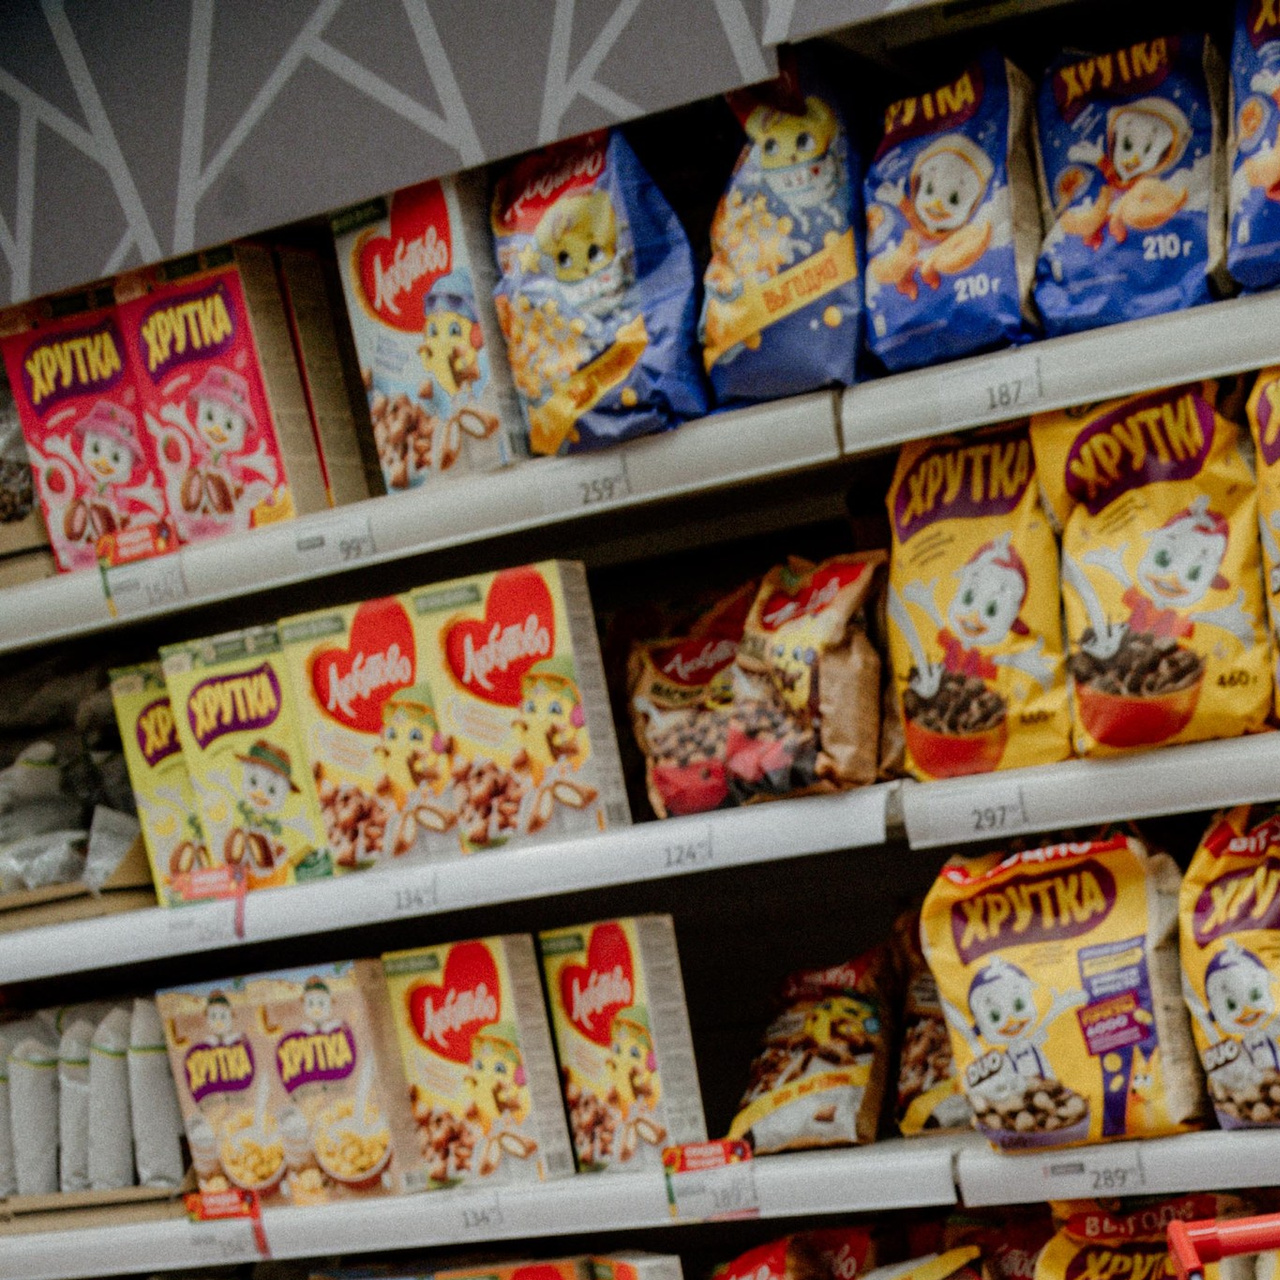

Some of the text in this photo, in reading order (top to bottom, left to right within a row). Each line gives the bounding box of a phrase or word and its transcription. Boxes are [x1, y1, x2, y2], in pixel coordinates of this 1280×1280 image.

[1142, 233, 1181, 262] 210
[954, 273, 988, 303] 210
[25, 330, 122, 405] ХРУТКА
[141, 294, 233, 372] ХРУТКА
[193, 672, 278, 743] ХРУТКА
[960, 871, 1107, 951] ХРУТКА
